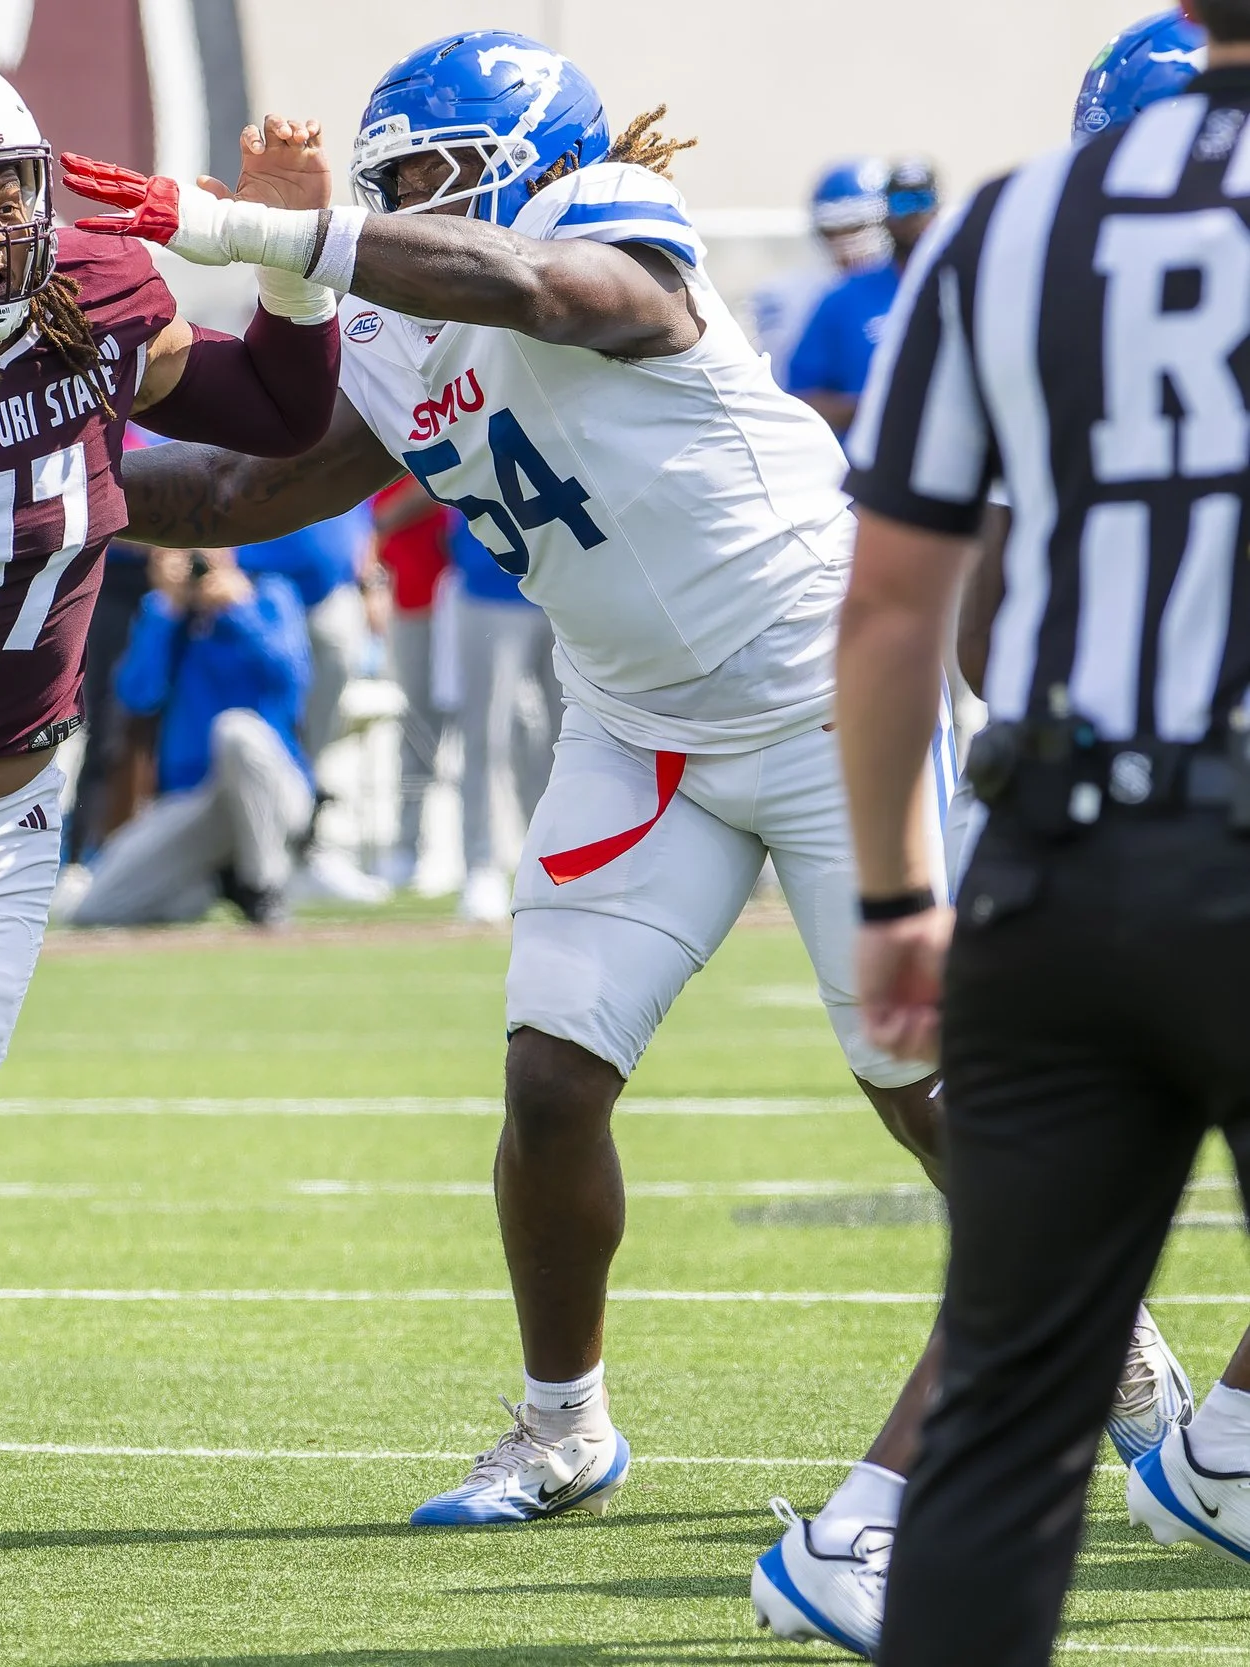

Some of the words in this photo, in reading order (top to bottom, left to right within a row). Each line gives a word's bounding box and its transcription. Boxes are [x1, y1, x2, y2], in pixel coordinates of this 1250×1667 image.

[369, 124, 386, 139] SMU
[351, 316, 378, 332] ACC
[1090, 206, 1250, 484] R
[408, 368, 485, 441] SMU
[402, 408, 608, 577] 54
[32, 741, 51, 749] adidas
